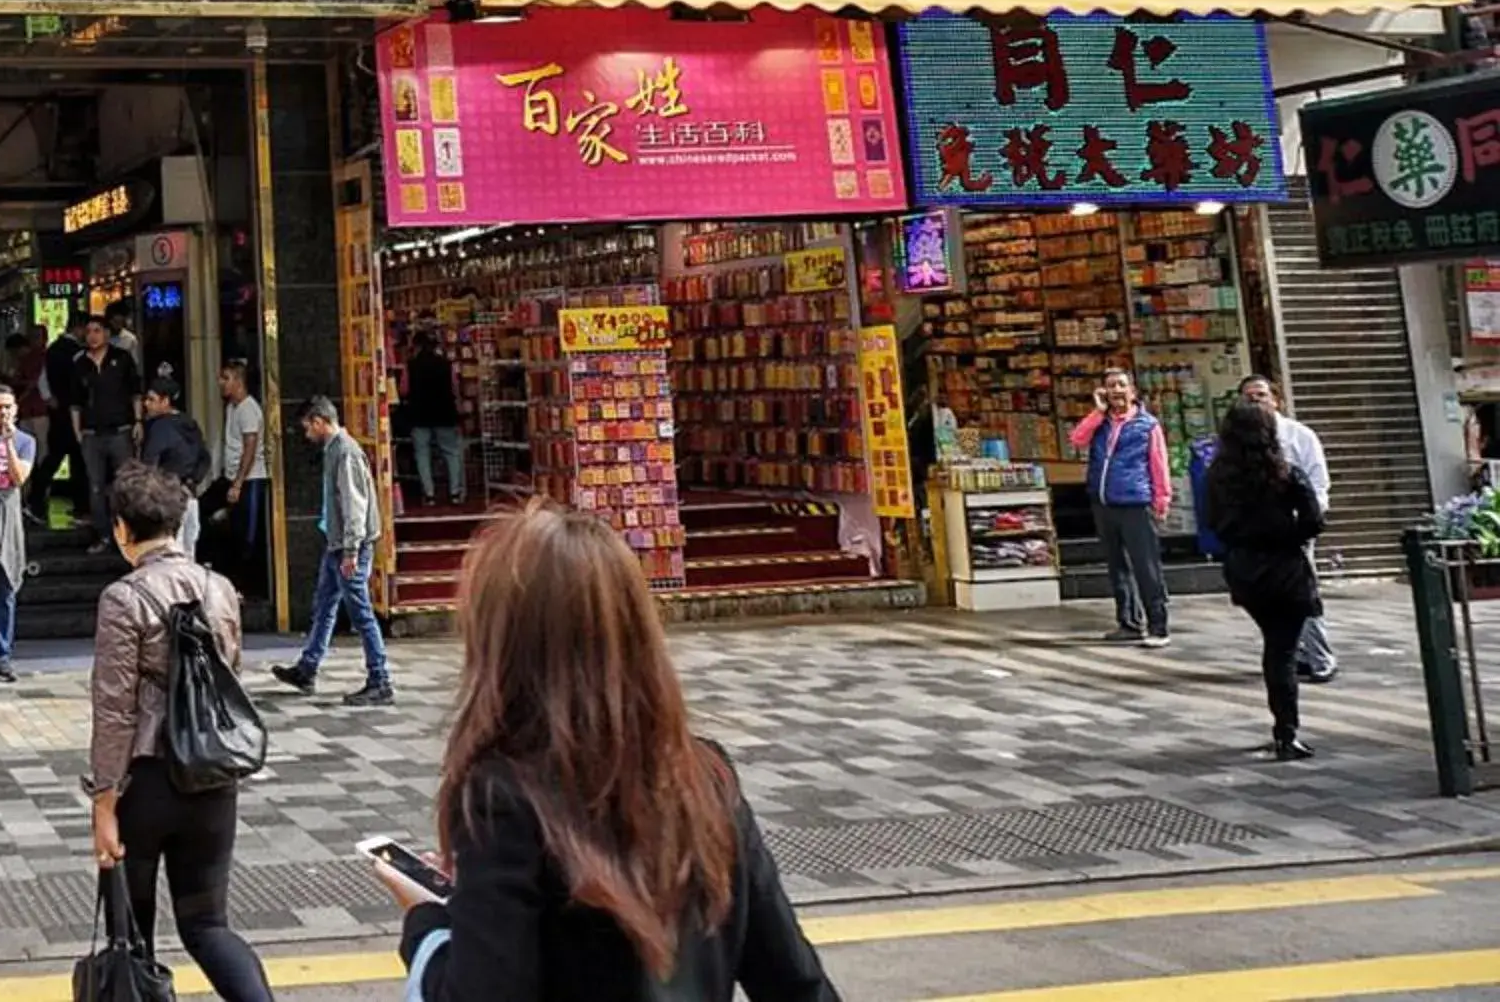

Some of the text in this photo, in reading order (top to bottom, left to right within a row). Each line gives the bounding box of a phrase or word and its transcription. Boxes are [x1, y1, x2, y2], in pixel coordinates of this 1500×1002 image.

[496, 56, 689, 167] 百家姓
[636, 119, 766, 145] 生活百科
